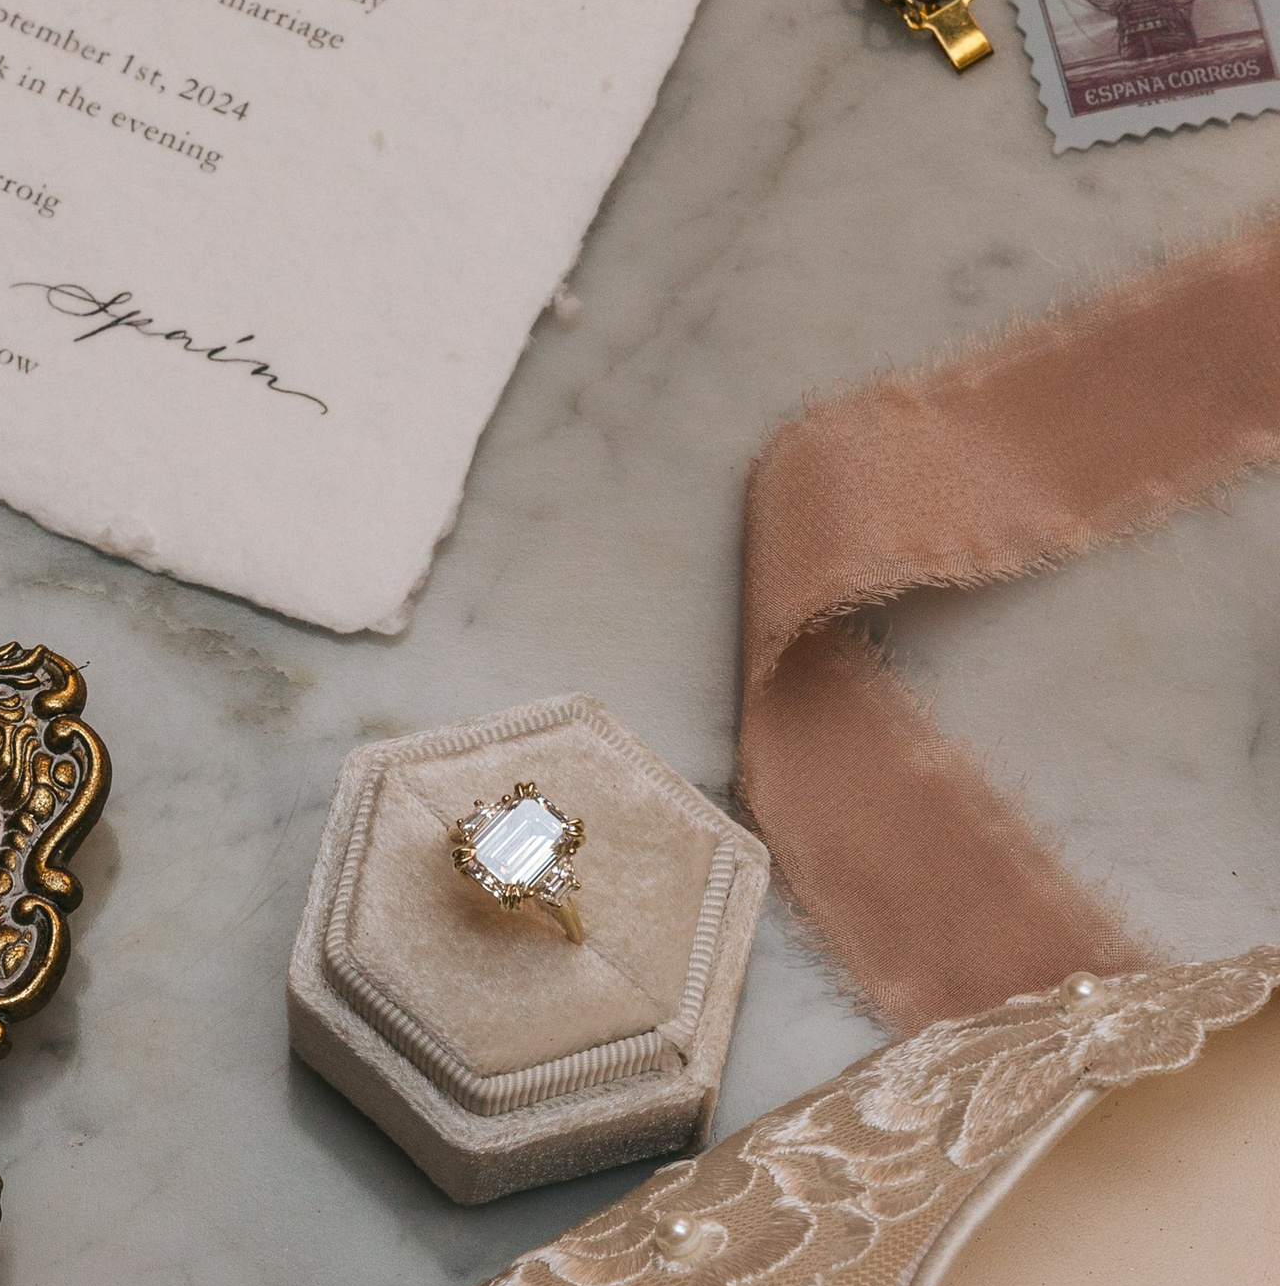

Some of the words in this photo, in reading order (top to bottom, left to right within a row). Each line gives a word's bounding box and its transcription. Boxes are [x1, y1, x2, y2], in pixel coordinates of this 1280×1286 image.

[17, 66, 47, 95] in
[56, 85, 102, 118] the
[111, 111, 224, 174] evening
[121, 53, 166, 94] 1st,
[178, 77, 251, 122] 2024
[1084, 75, 1165, 106] ESPAÑA
[1167, 60, 1261, 89] CORREOS
[10, 282, 328, 415] Spain
